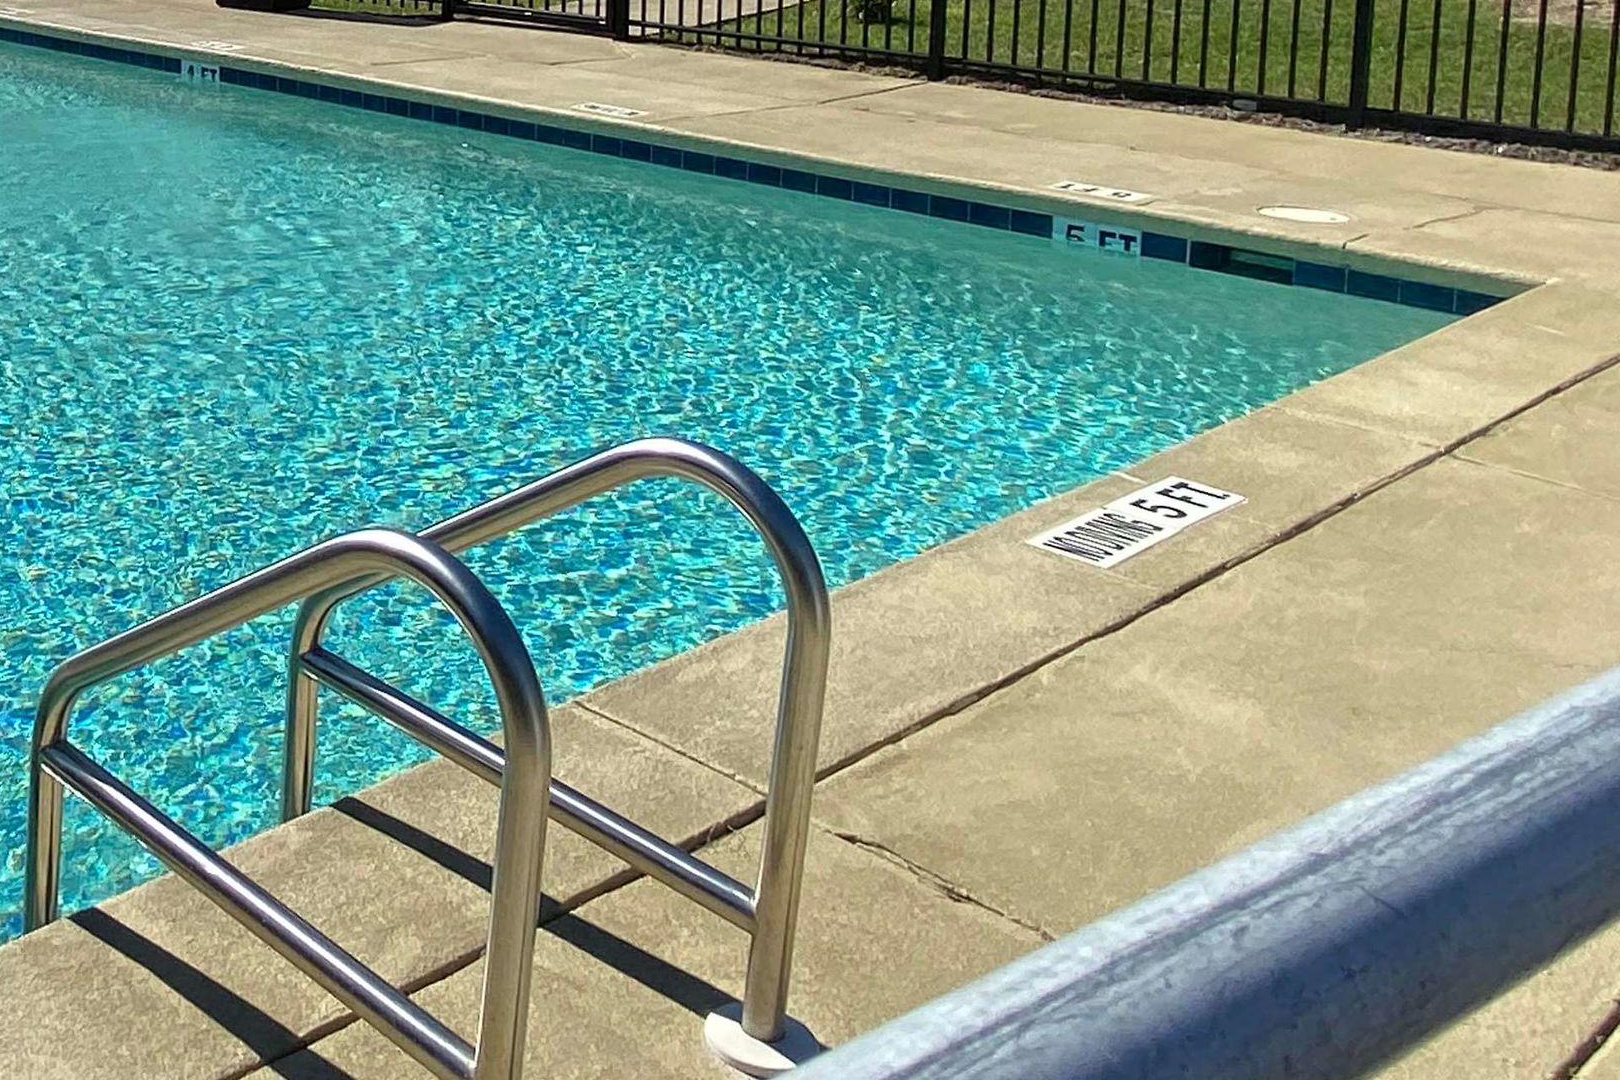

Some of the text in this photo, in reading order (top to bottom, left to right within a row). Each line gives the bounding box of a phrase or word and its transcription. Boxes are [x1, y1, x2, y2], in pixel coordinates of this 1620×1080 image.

[201, 66, 217, 82] FT
[1098, 230, 1137, 252] FT
[1129, 498, 1188, 519] 5
[1064, 513, 1164, 550] DIVING
[1042, 536, 1114, 562] NO
